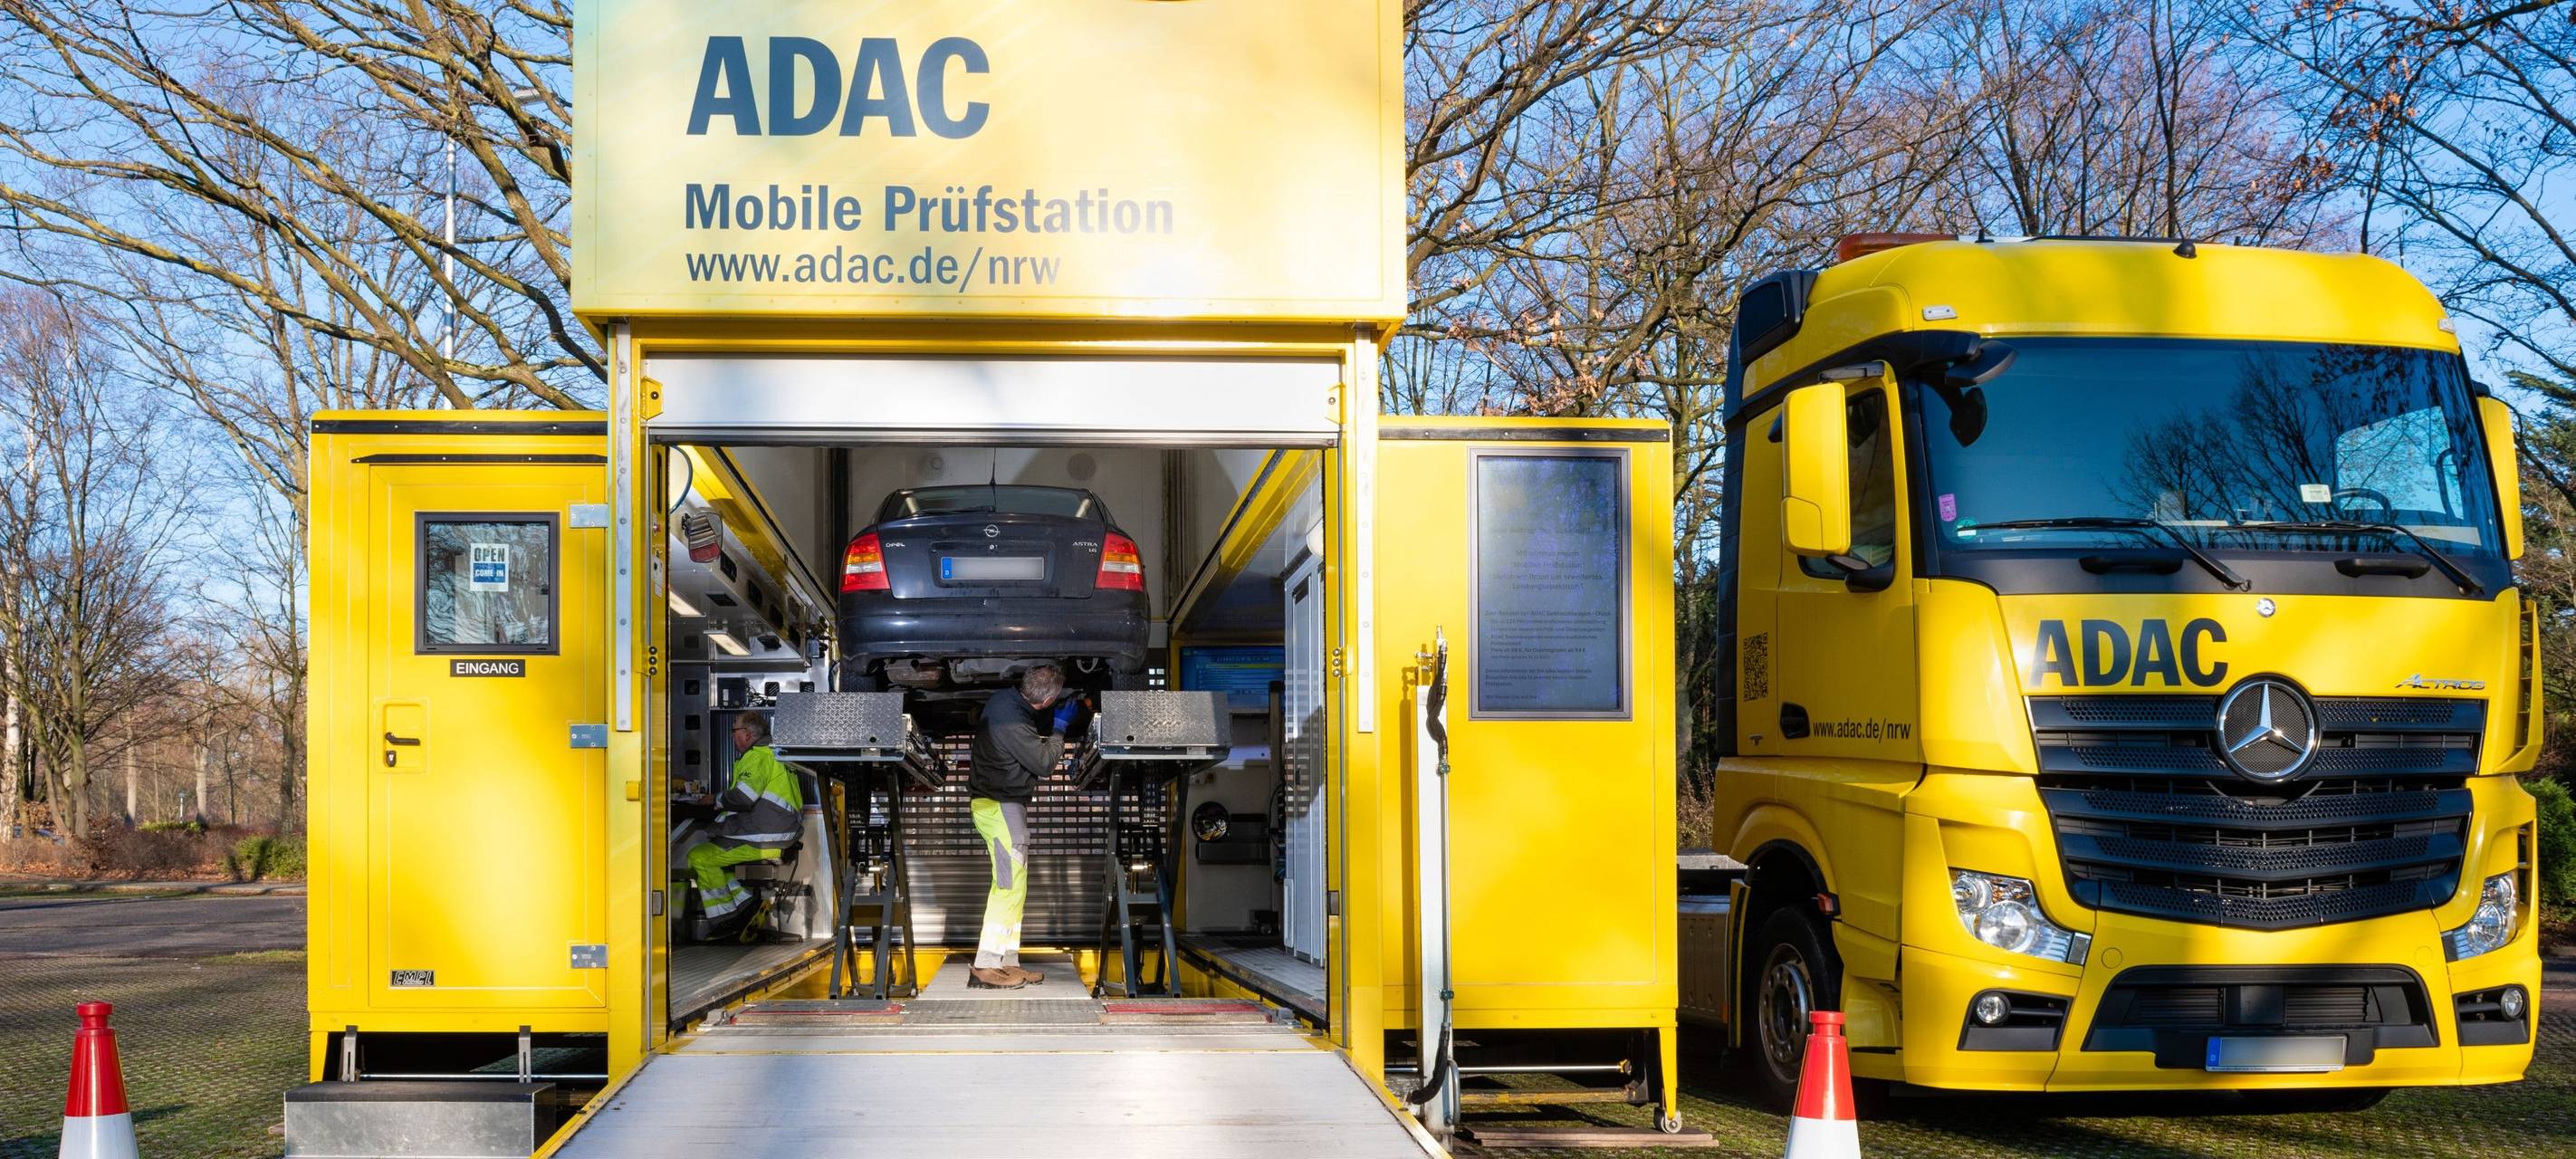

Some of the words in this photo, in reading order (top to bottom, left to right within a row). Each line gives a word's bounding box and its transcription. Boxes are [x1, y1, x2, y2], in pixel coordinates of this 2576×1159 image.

[686, 36, 990, 139] ADAC
[685, 183, 862, 233] Mobile
[885, 184, 1173, 235] Prüfstation
[685, 244, 1061, 294] www.adac.de/nrw
[474, 547, 505, 562] OPEN
[474, 569, 494, 577] COME
[2030, 618, 2228, 686] ADAC
[455, 662, 519, 675] EINGANG
[1813, 718, 1910, 743] www.adac.de/nrw
[393, 971, 432, 985] EMPL
